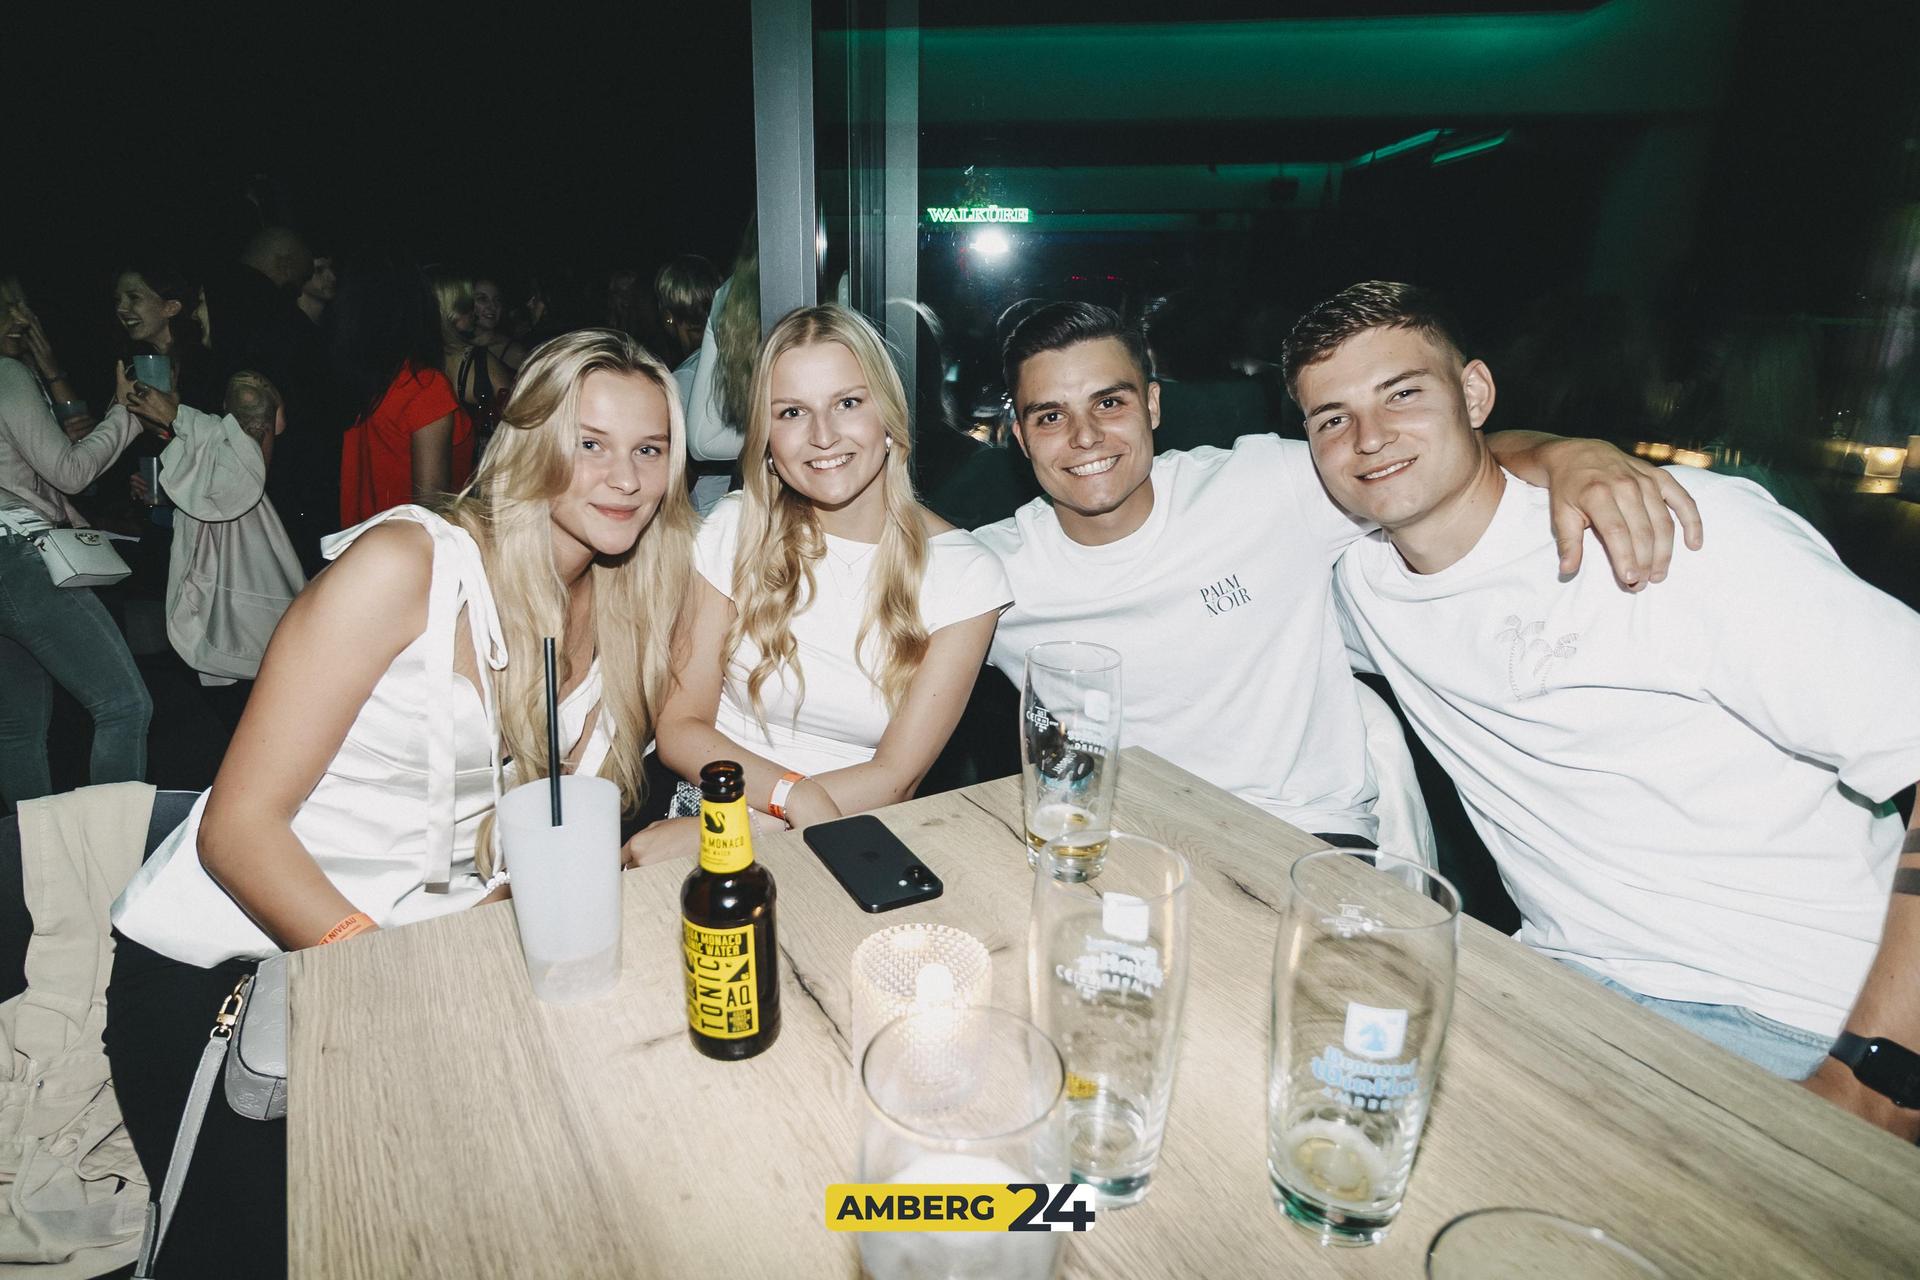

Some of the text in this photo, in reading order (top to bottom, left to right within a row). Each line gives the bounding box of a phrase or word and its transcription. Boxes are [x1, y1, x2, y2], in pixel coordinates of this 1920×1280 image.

[927, 205, 1030, 223] WALKÜRE
[1200, 574, 1241, 603] PALM
[1206, 588, 1252, 617] NOIR
[708, 835, 744, 849] MONACO
[328, 917, 357, 940] NIVEAU
[700, 932, 742, 946] MONACO
[704, 943, 741, 957] WATER
[697, 956, 724, 1030] TONIC
